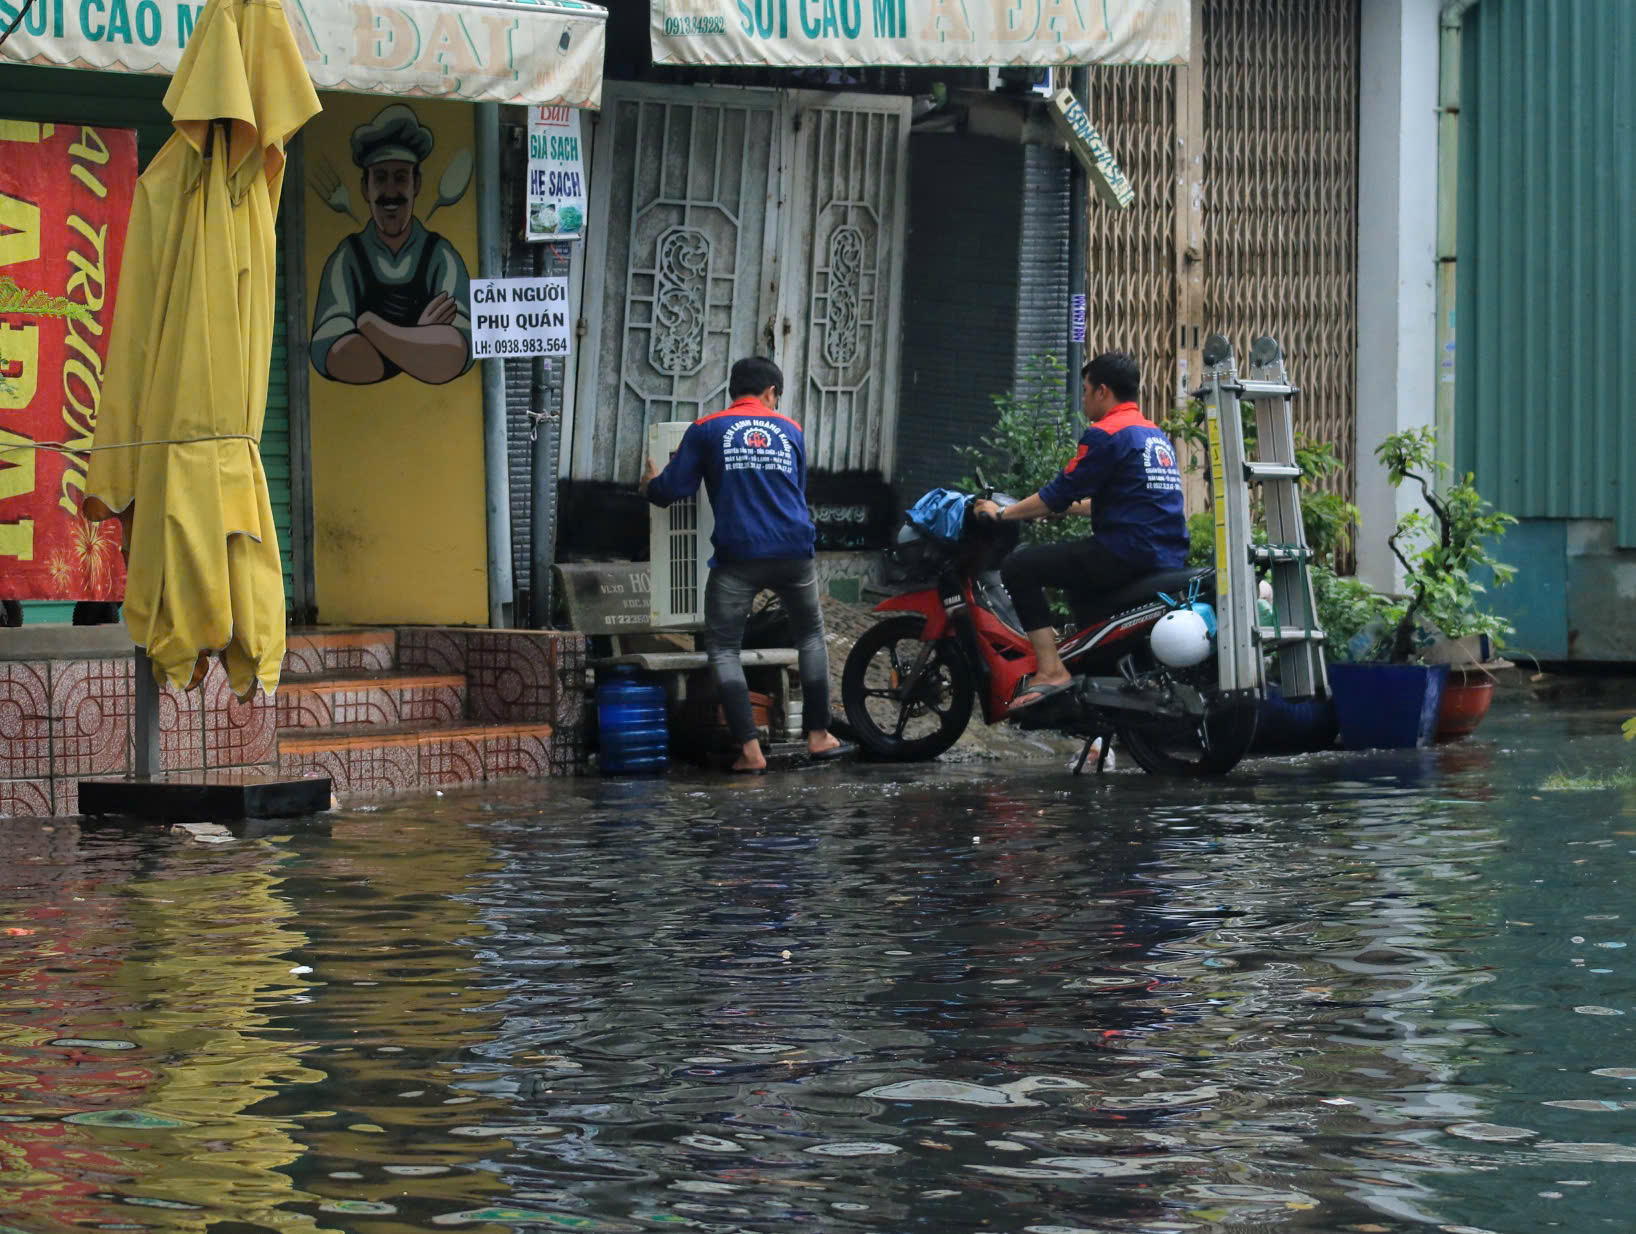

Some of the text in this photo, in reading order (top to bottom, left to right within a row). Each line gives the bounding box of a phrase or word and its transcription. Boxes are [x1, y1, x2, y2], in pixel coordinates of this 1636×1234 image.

[530, 130, 579, 166] GIÁ SẠCH
[548, 170, 582, 202] SẠCH
[473, 282, 566, 304] CẦN NGƯỜI
[477, 309, 564, 334] PHỤ QUÁN
[475, 337, 568, 355] LH: 0938.983.564
